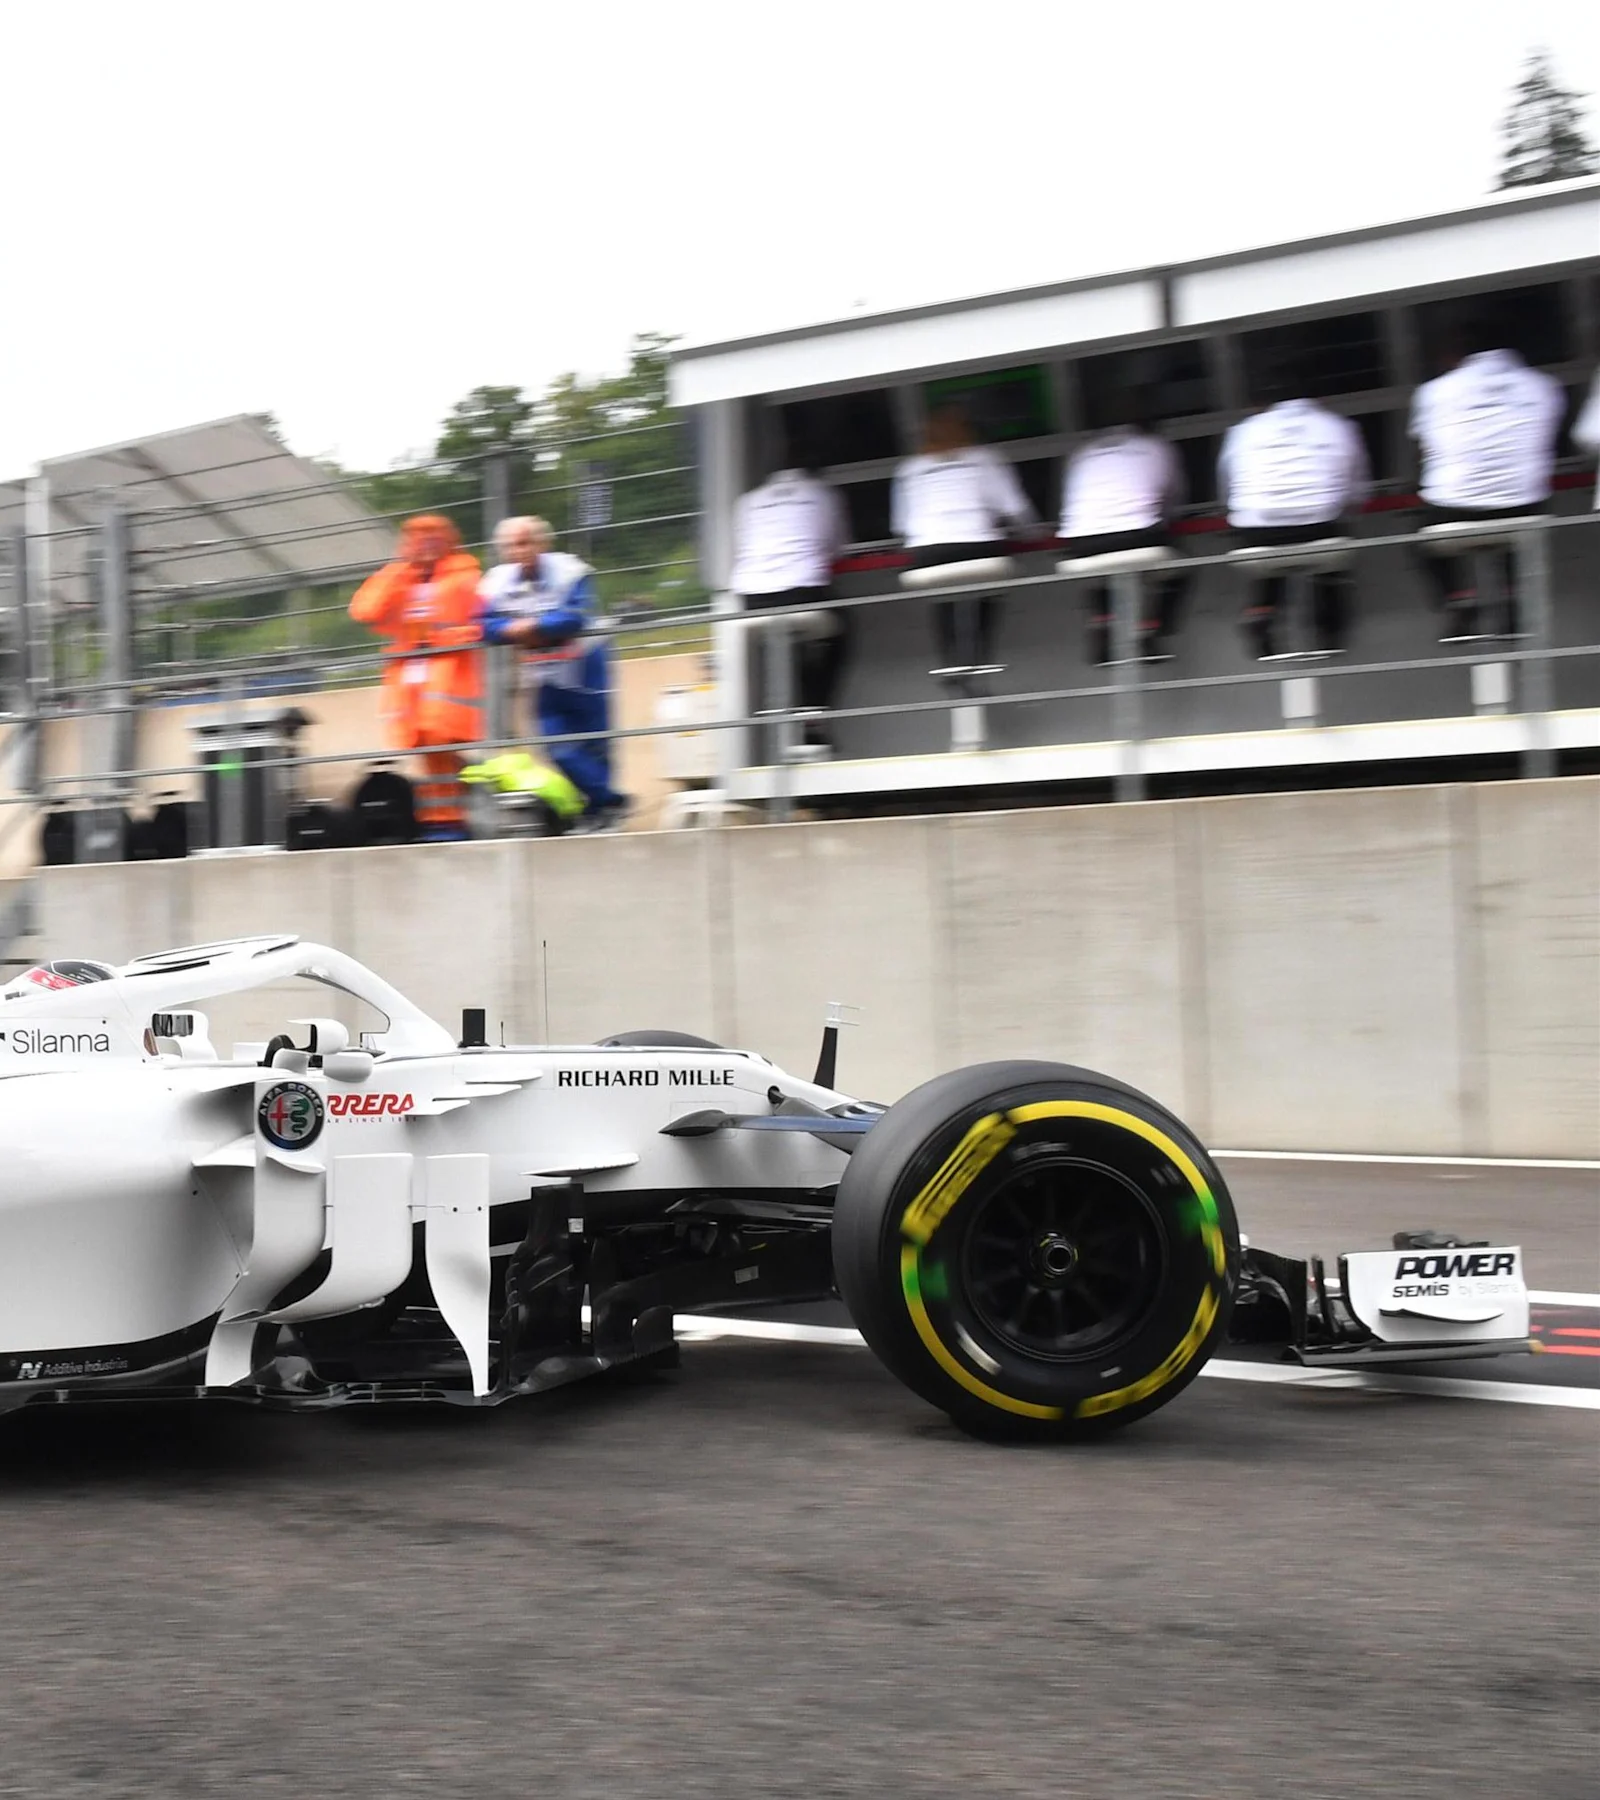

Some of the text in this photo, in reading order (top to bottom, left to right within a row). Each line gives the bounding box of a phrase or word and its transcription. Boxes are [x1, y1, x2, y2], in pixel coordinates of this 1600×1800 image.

[12, 1029, 110, 1054] Silanna
[557, 1069, 735, 1087] RICHARD MILLE
[259, 1082, 323, 1117] ALFA ROMEO
[326, 1093, 415, 1116] RRERA
[1394, 1253, 1515, 1280] POWER
